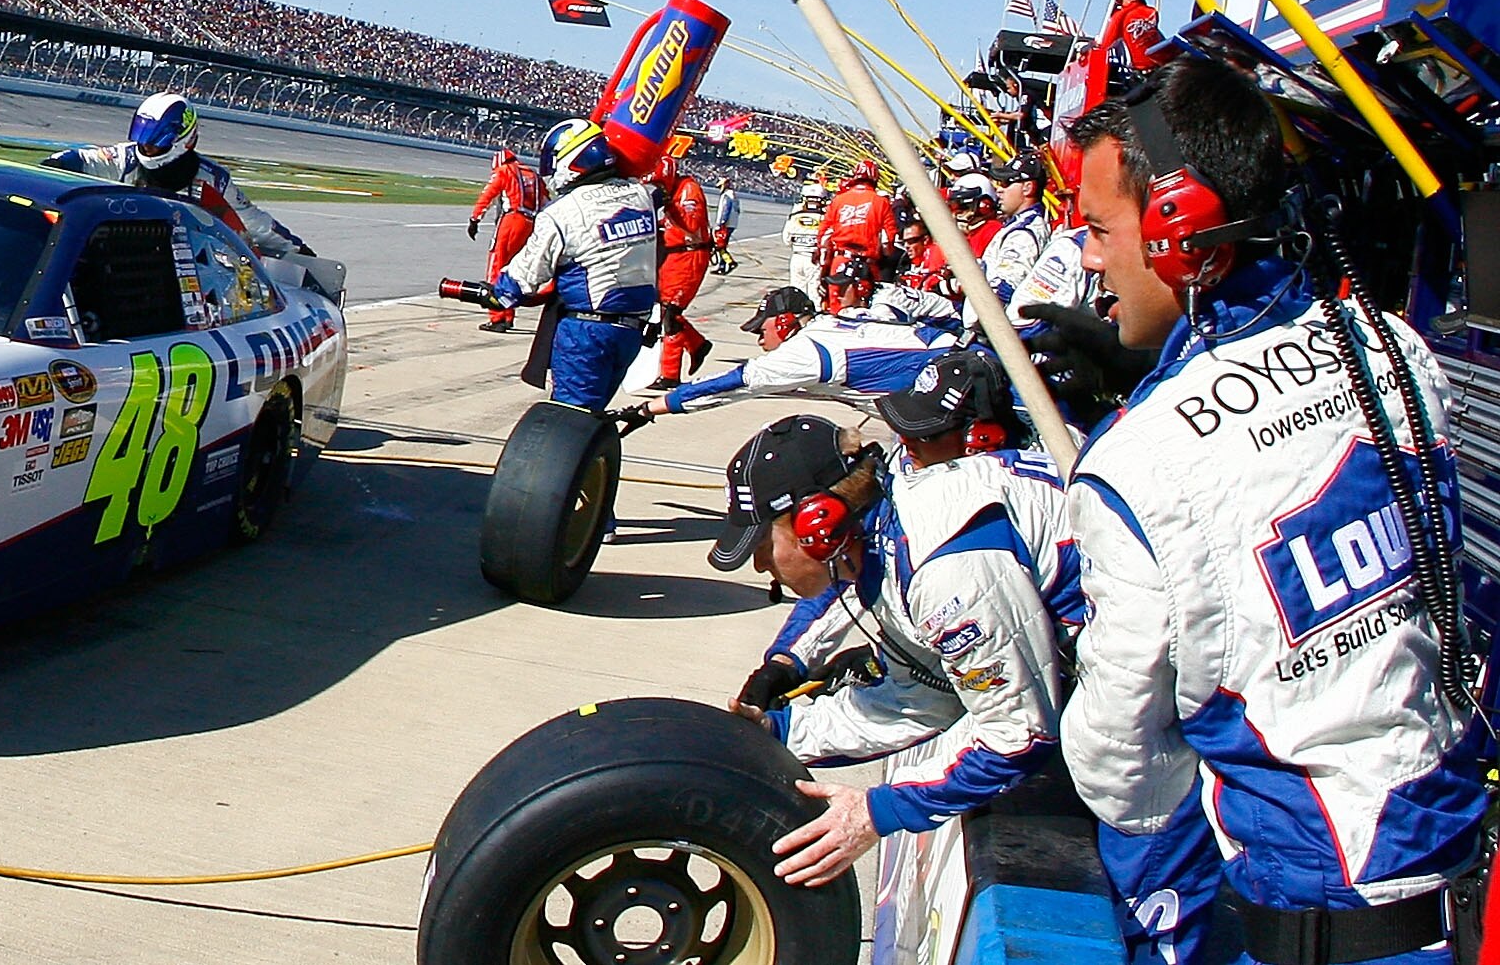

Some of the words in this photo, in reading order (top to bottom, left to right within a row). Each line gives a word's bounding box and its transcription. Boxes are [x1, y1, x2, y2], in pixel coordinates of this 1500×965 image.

[633, 25, 686, 121] SUNOCO
[603, 215, 652, 241] LOWE'S
[53, 439, 90, 466] JEGS
[84, 342, 217, 546] 48
[13, 469, 44, 488] TISSOT
[1275, 648, 1328, 683] Let's
[1333, 612, 1387, 658] Build
